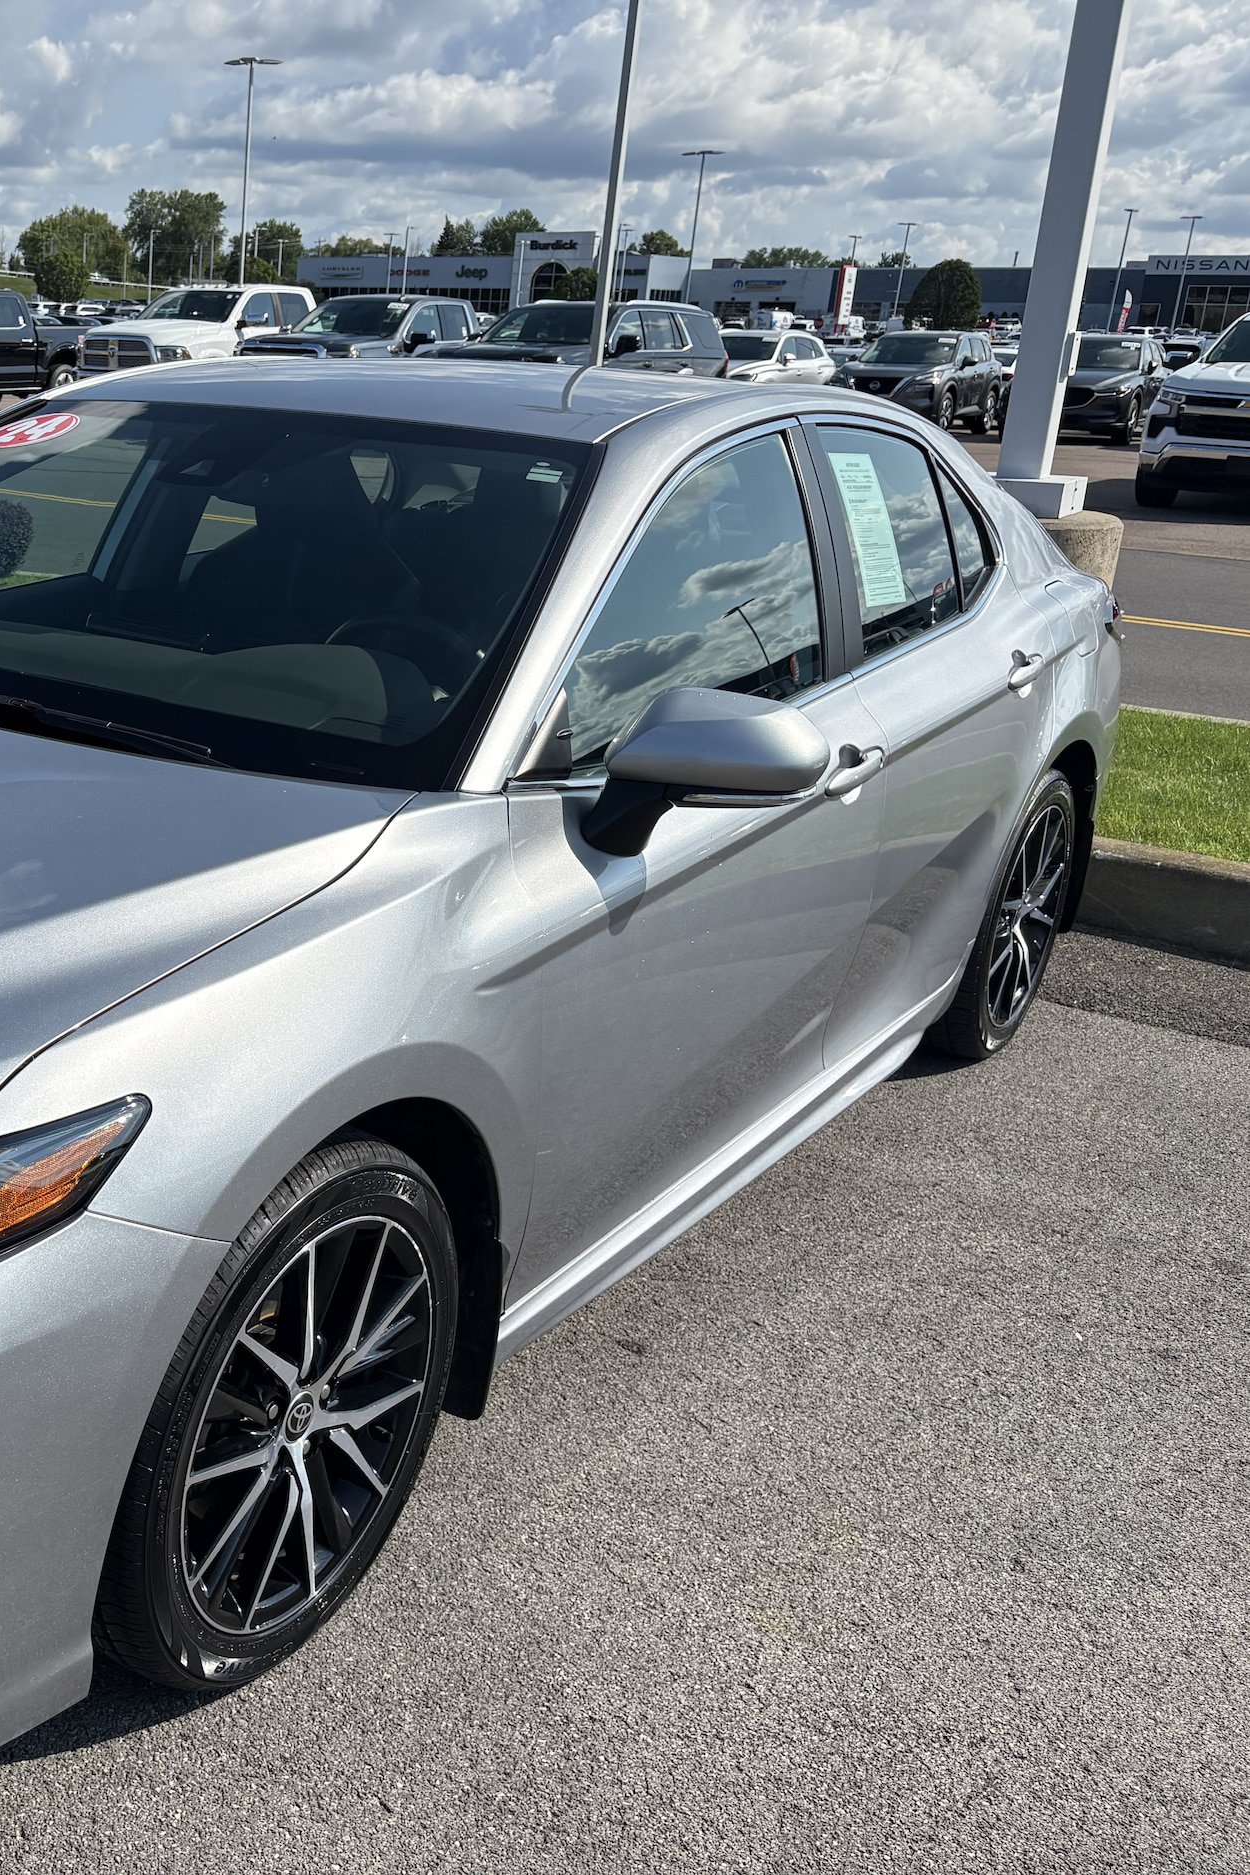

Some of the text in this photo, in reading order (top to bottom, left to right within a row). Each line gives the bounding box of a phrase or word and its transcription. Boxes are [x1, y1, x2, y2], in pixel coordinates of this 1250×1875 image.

[530, 239, 578, 250] Burdick
[1156, 259, 1249, 270] NISSAN
[455, 265, 488, 280] Jeep
